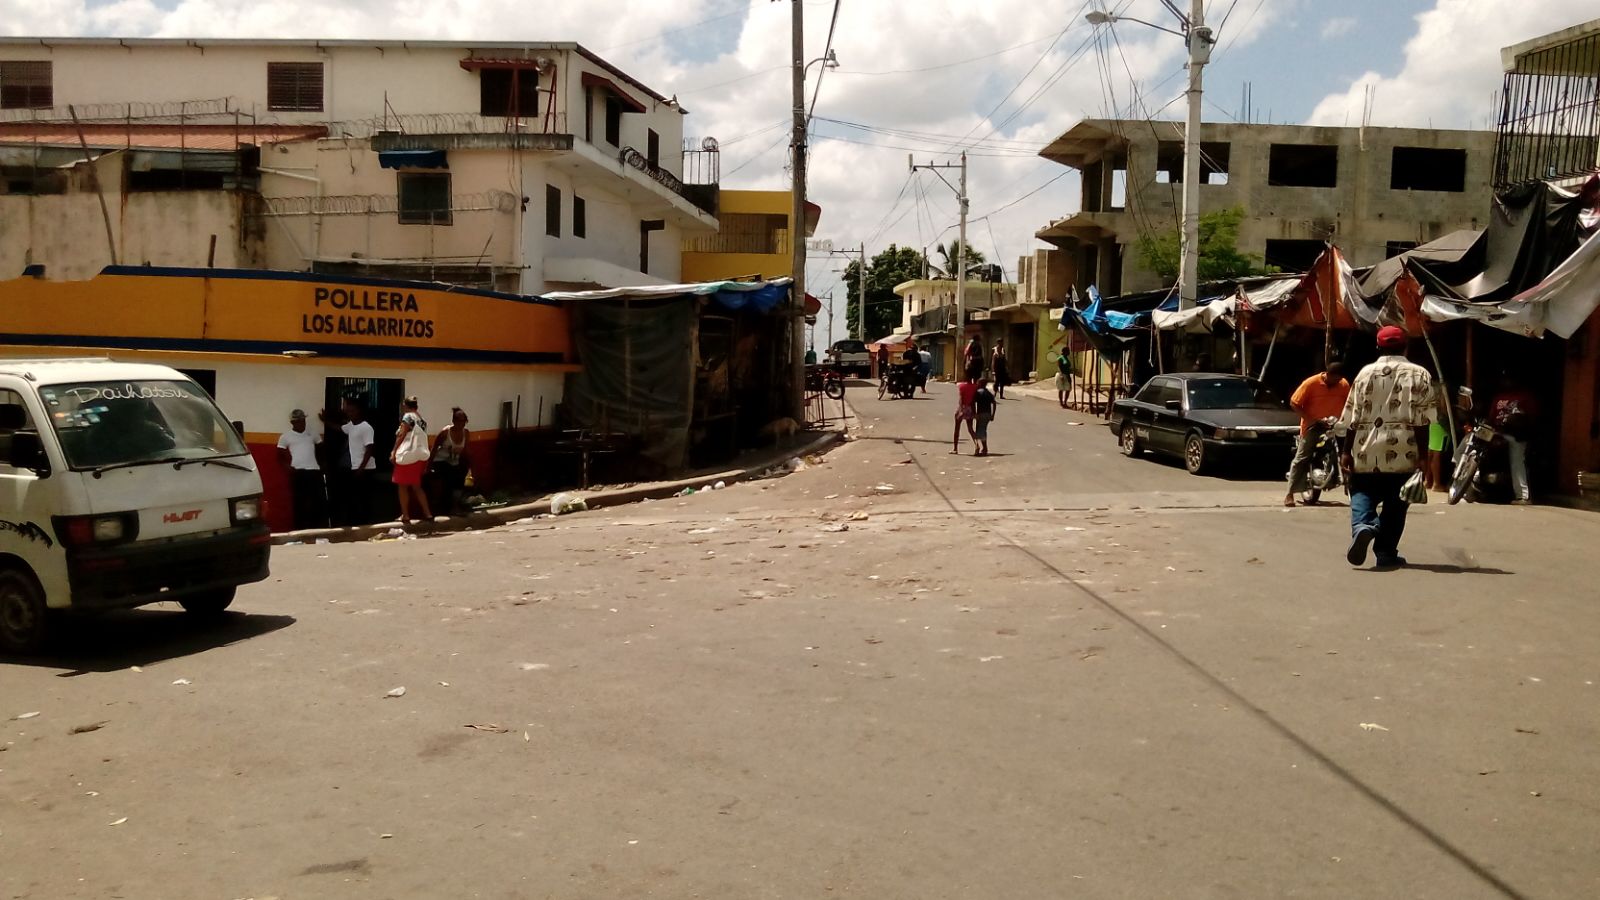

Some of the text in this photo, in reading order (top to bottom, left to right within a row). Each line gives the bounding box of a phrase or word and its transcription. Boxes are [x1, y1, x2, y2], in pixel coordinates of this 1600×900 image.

[315, 287, 419, 312] POLLERA
[303, 314, 434, 339] LOS ALCARRIZOS
[65, 383, 189, 404] Daihatsu
